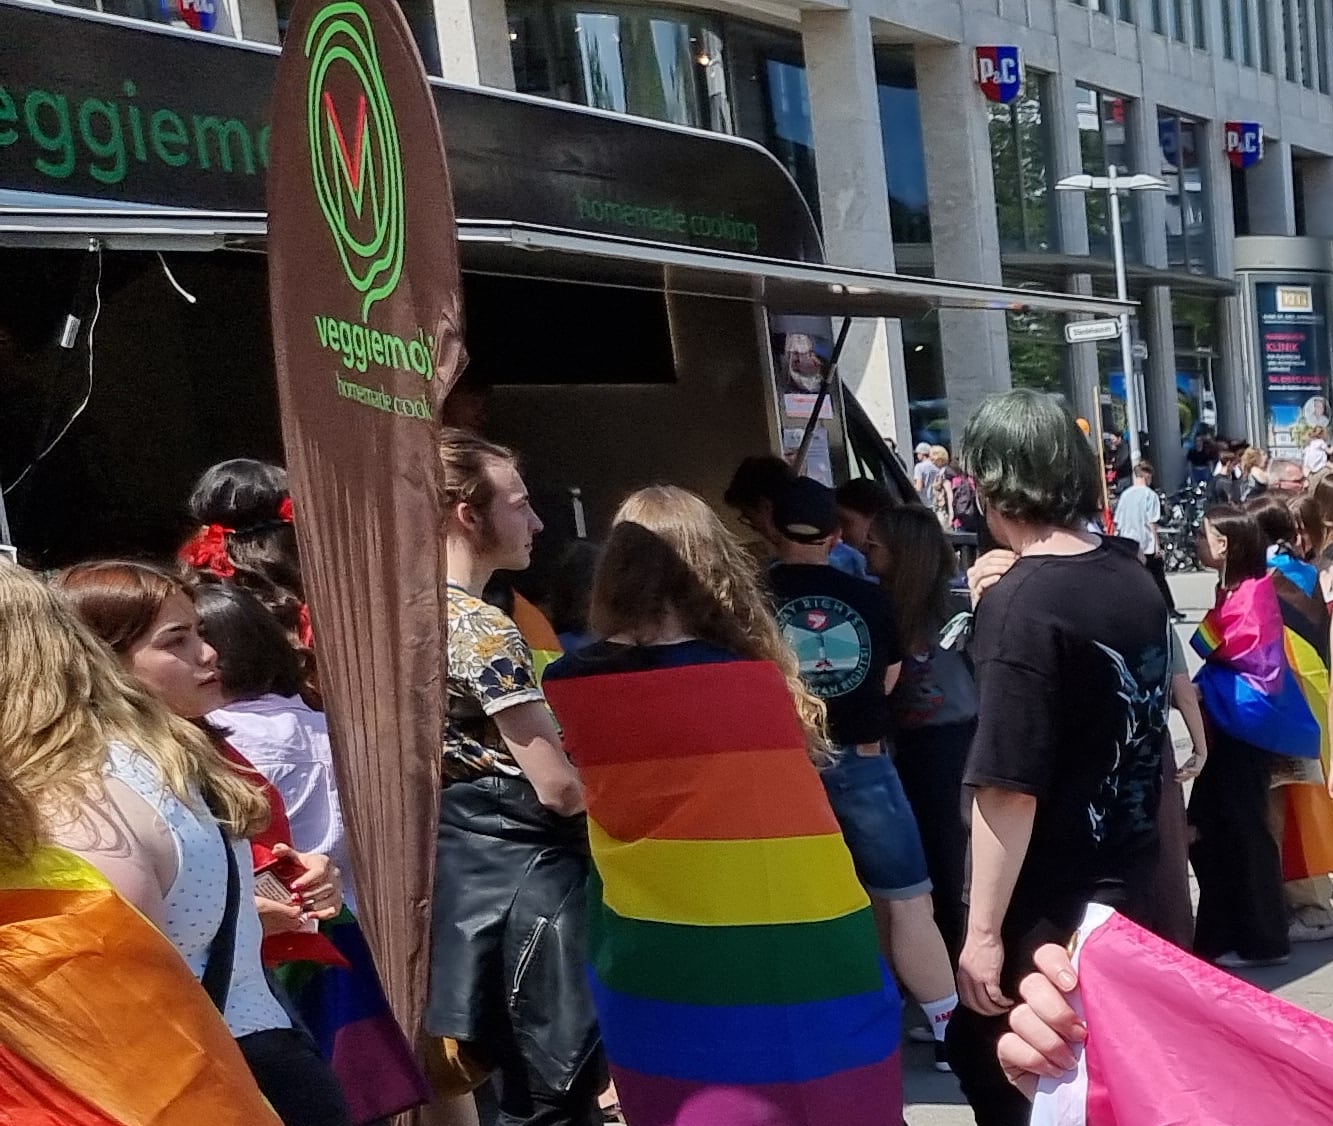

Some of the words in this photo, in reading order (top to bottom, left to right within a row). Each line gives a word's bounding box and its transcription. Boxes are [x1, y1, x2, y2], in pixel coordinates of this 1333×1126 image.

[979, 57, 1017, 84] P&C
[1227, 130, 1257, 153] P&C
[336, 370, 393, 413] homemade
[802, 598, 859, 626] RIGHTS
